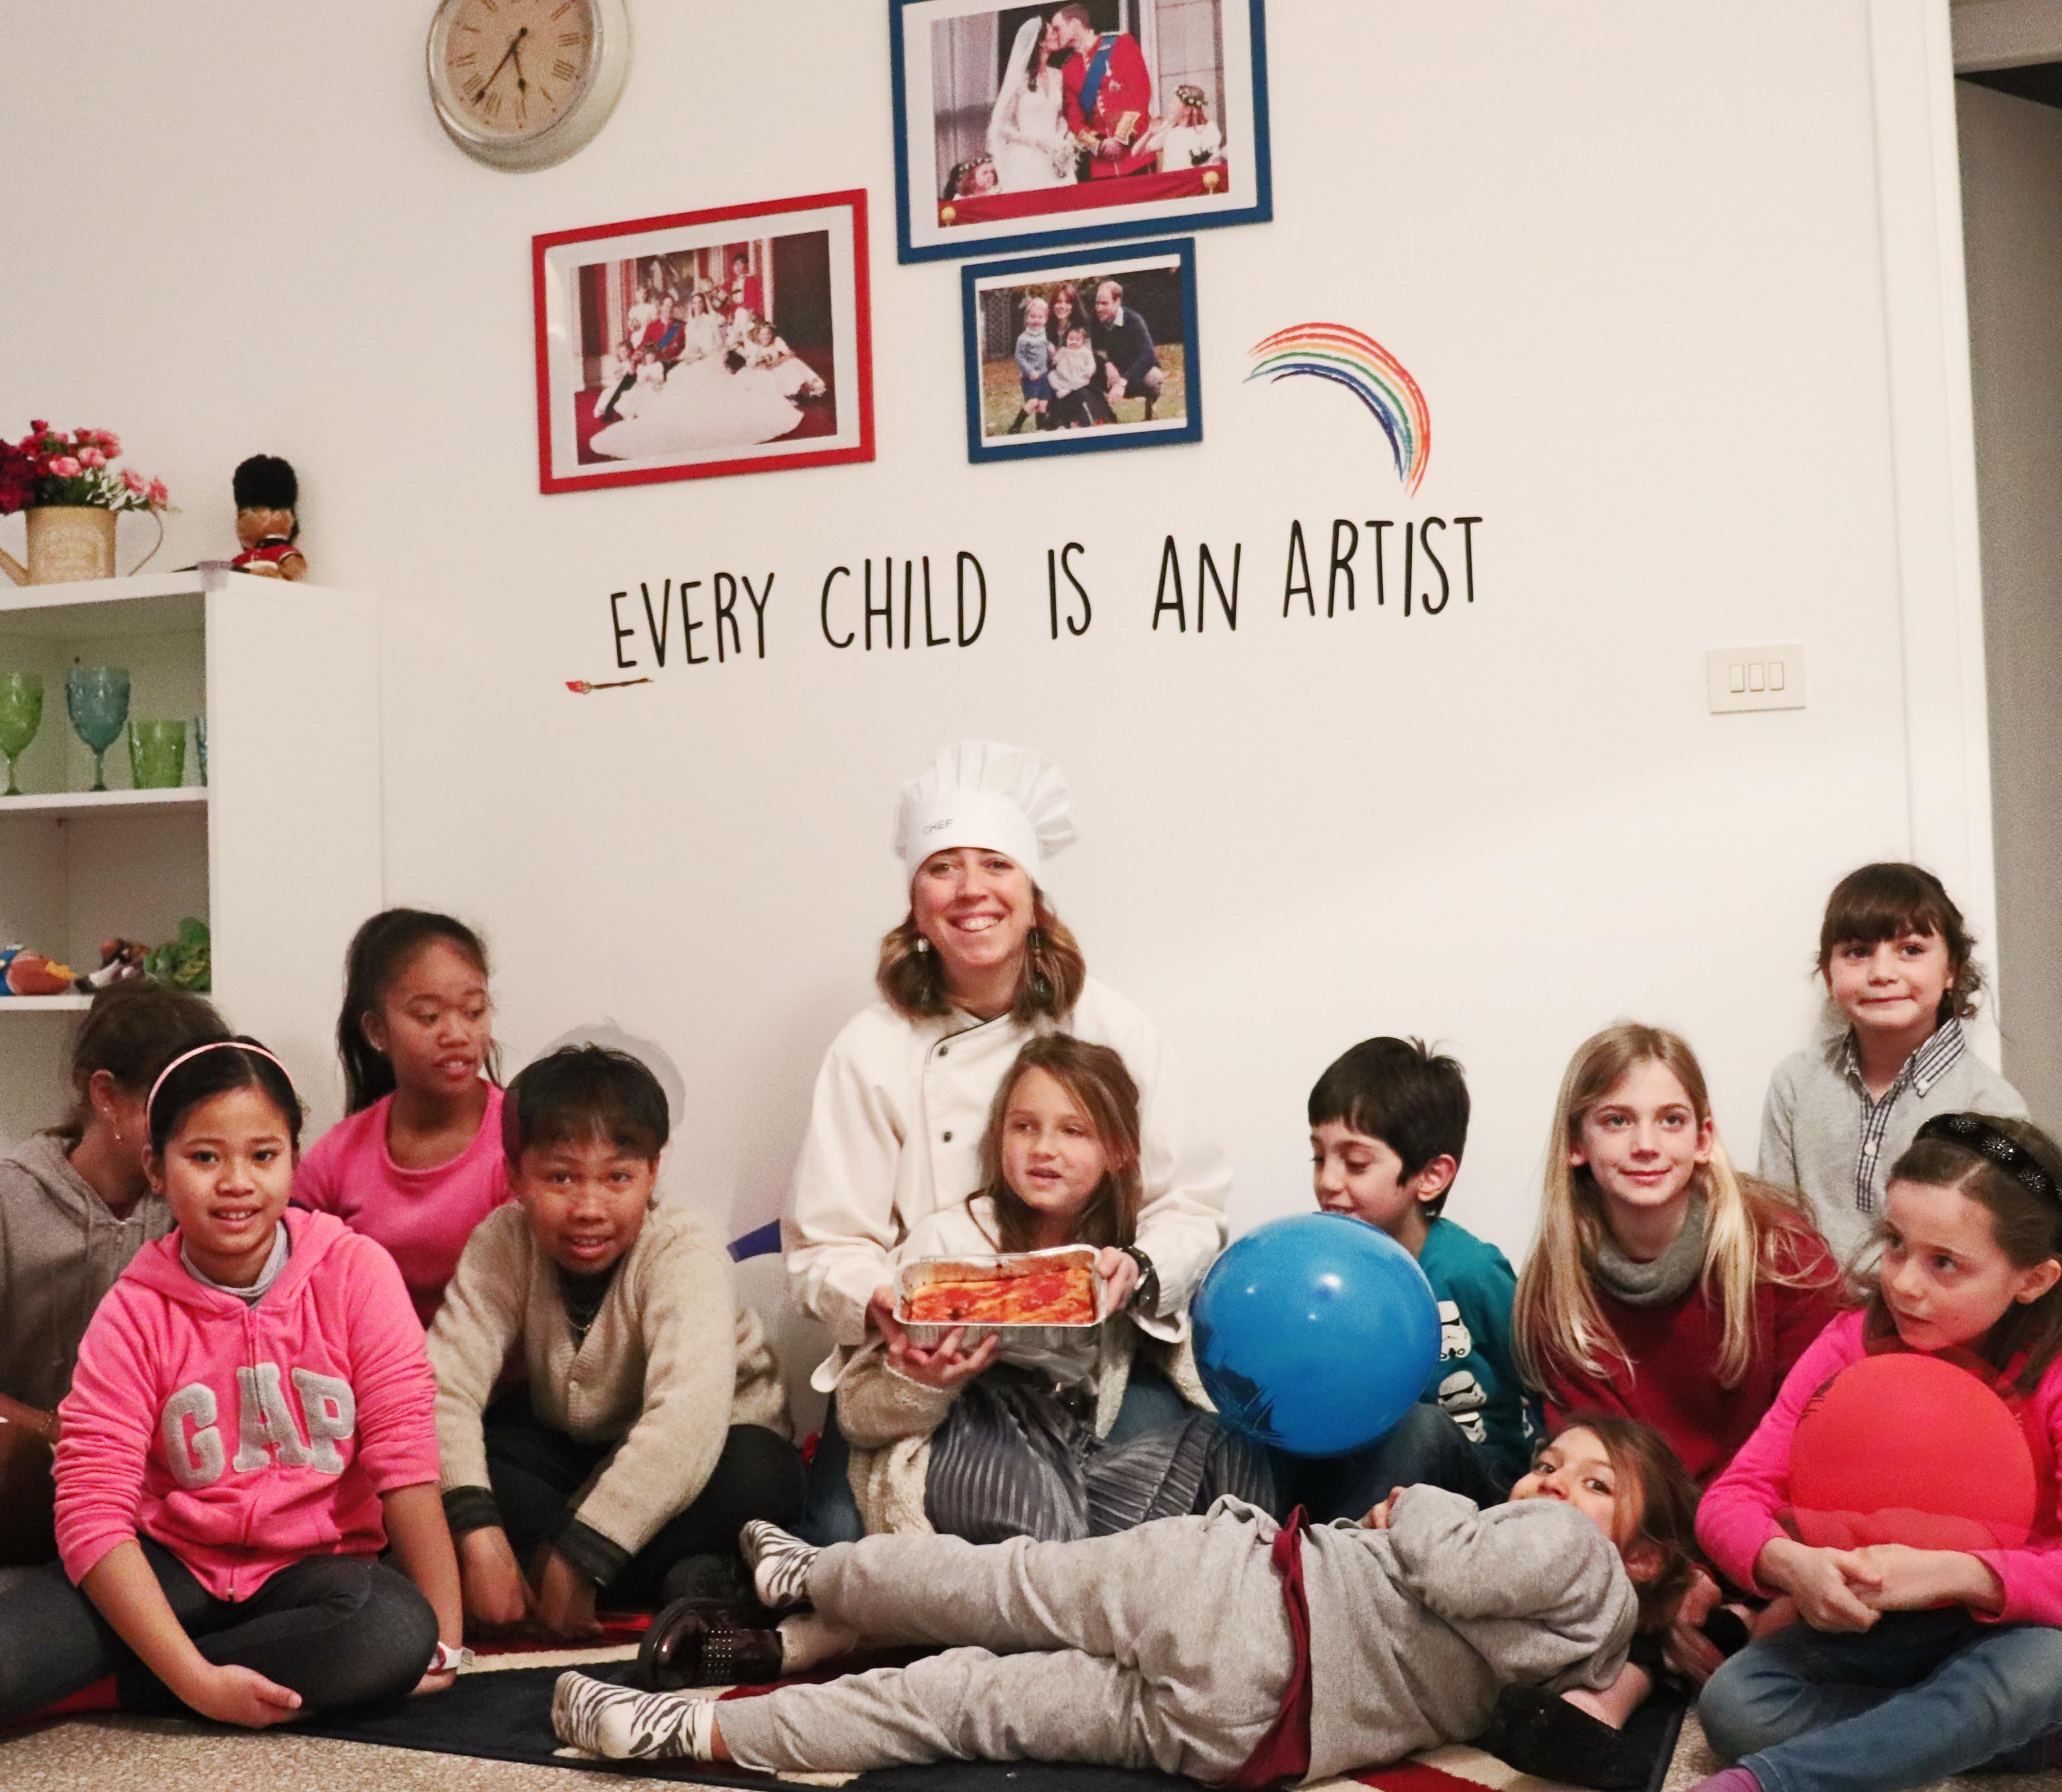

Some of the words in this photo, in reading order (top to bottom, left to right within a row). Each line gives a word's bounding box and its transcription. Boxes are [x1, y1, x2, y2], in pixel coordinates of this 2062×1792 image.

[610, 572, 775, 669] EVERY
[821, 551, 987, 651] CHILD
[1047, 542, 1092, 640] IS
[1152, 535, 1242, 633] AN
[1283, 516, 1484, 618] ARTIST
[923, 819, 954, 835] CHEF
[161, 1362, 355, 1490] GAP
